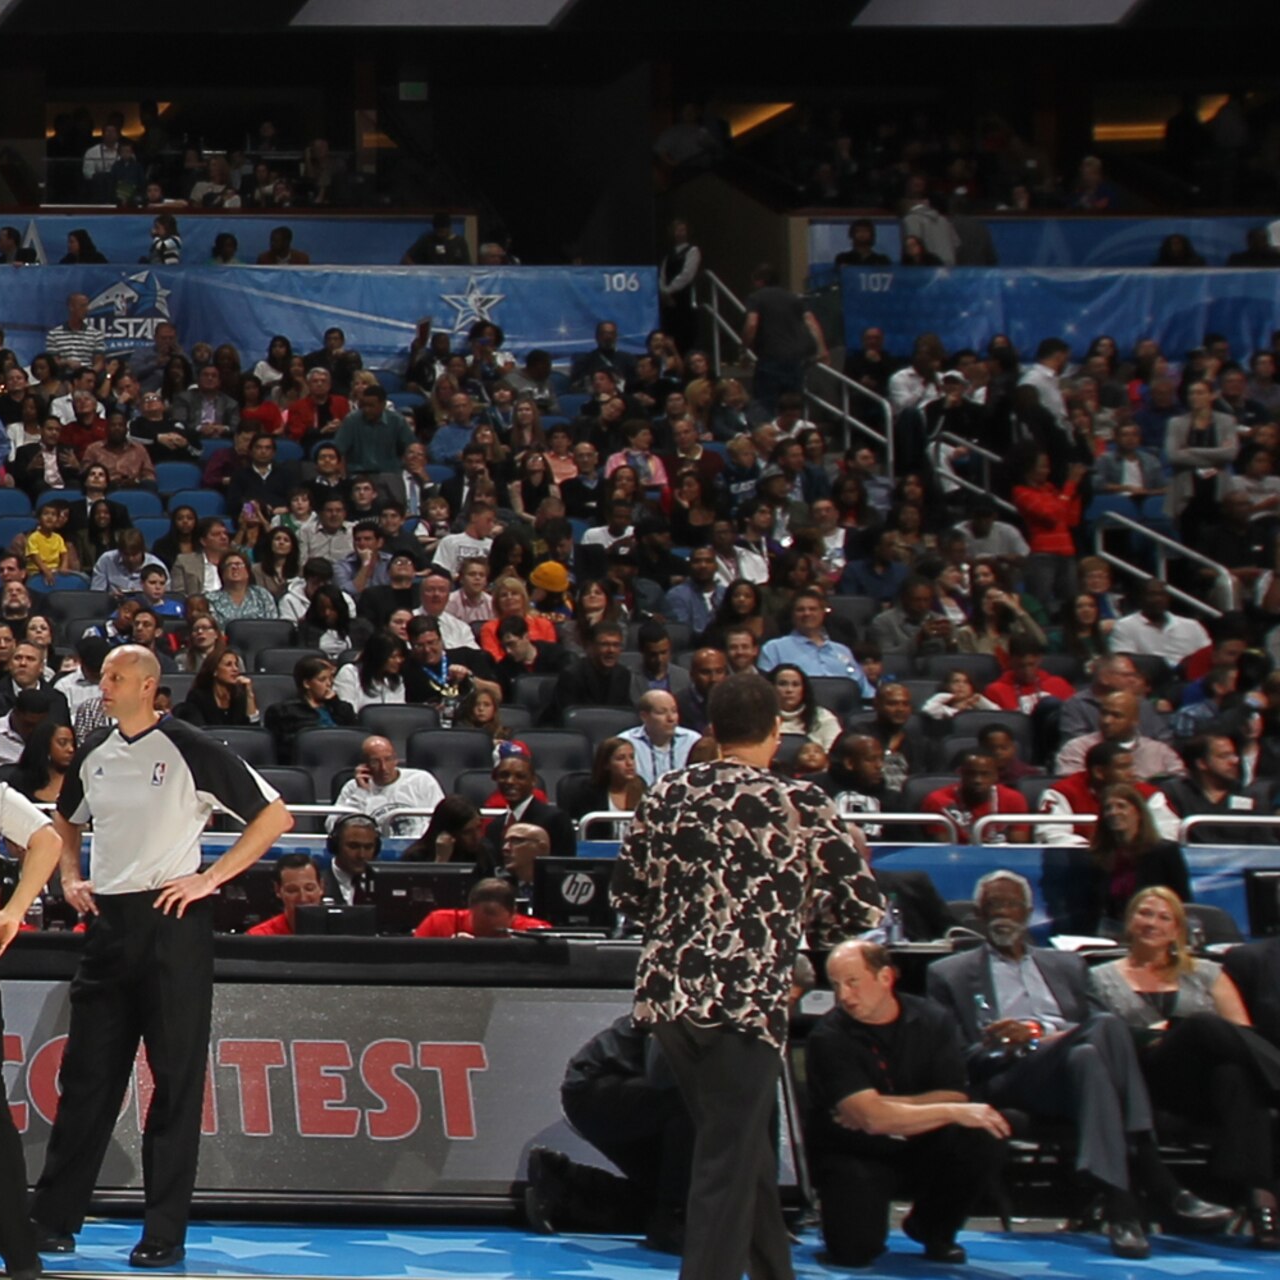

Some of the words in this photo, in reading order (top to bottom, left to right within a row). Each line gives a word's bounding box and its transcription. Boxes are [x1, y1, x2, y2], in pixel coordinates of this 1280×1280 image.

[603, 272, 640, 292] 106
[859, 272, 894, 292] 107
[565, 873, 593, 905] hp
